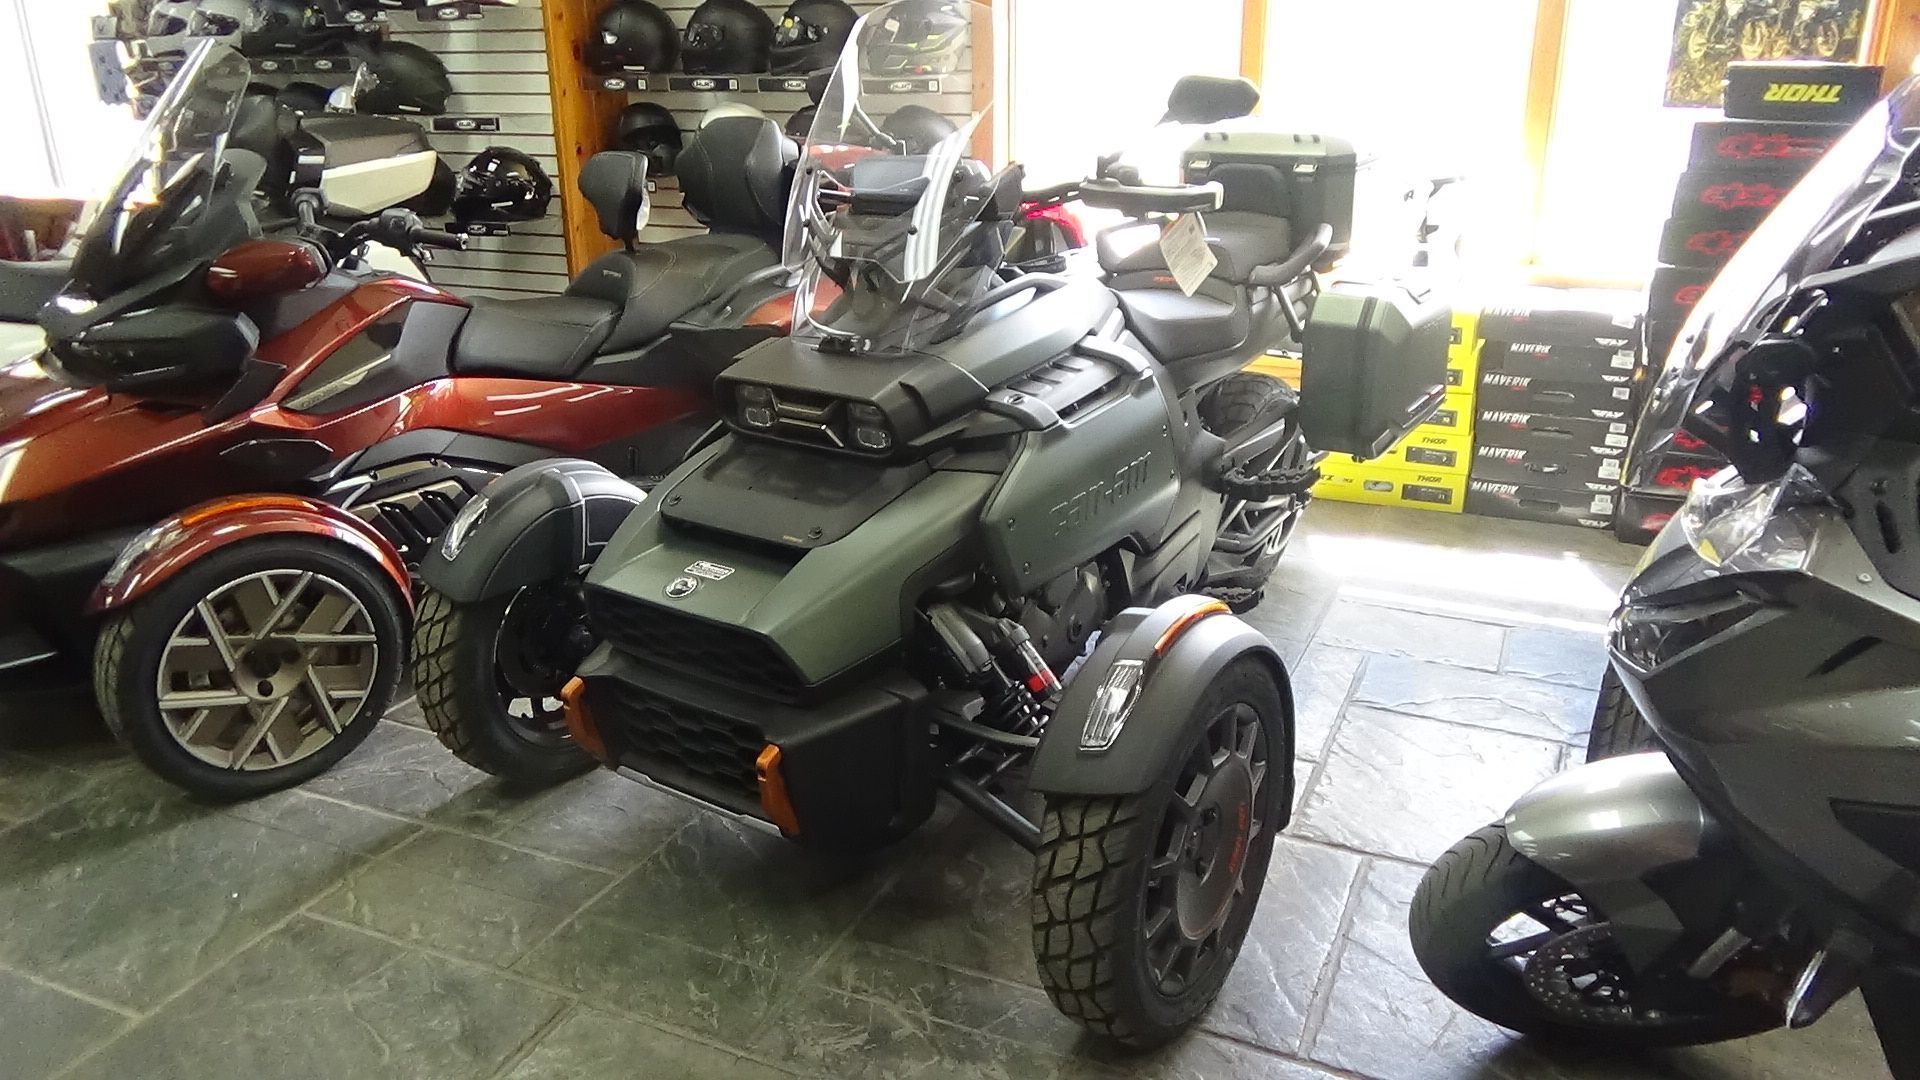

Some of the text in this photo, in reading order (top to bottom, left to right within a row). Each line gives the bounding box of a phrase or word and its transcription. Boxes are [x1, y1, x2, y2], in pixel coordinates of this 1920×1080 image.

[1763, 83, 1842, 103] THOR
[1510, 343, 1551, 353] MAVERIK
[1482, 373, 1532, 387] MAVERIK
[1482, 410, 1531, 424] MAVERIK
[1478, 446, 1527, 459] MAVERIK
[1471, 481, 1519, 495] MAVERIK
